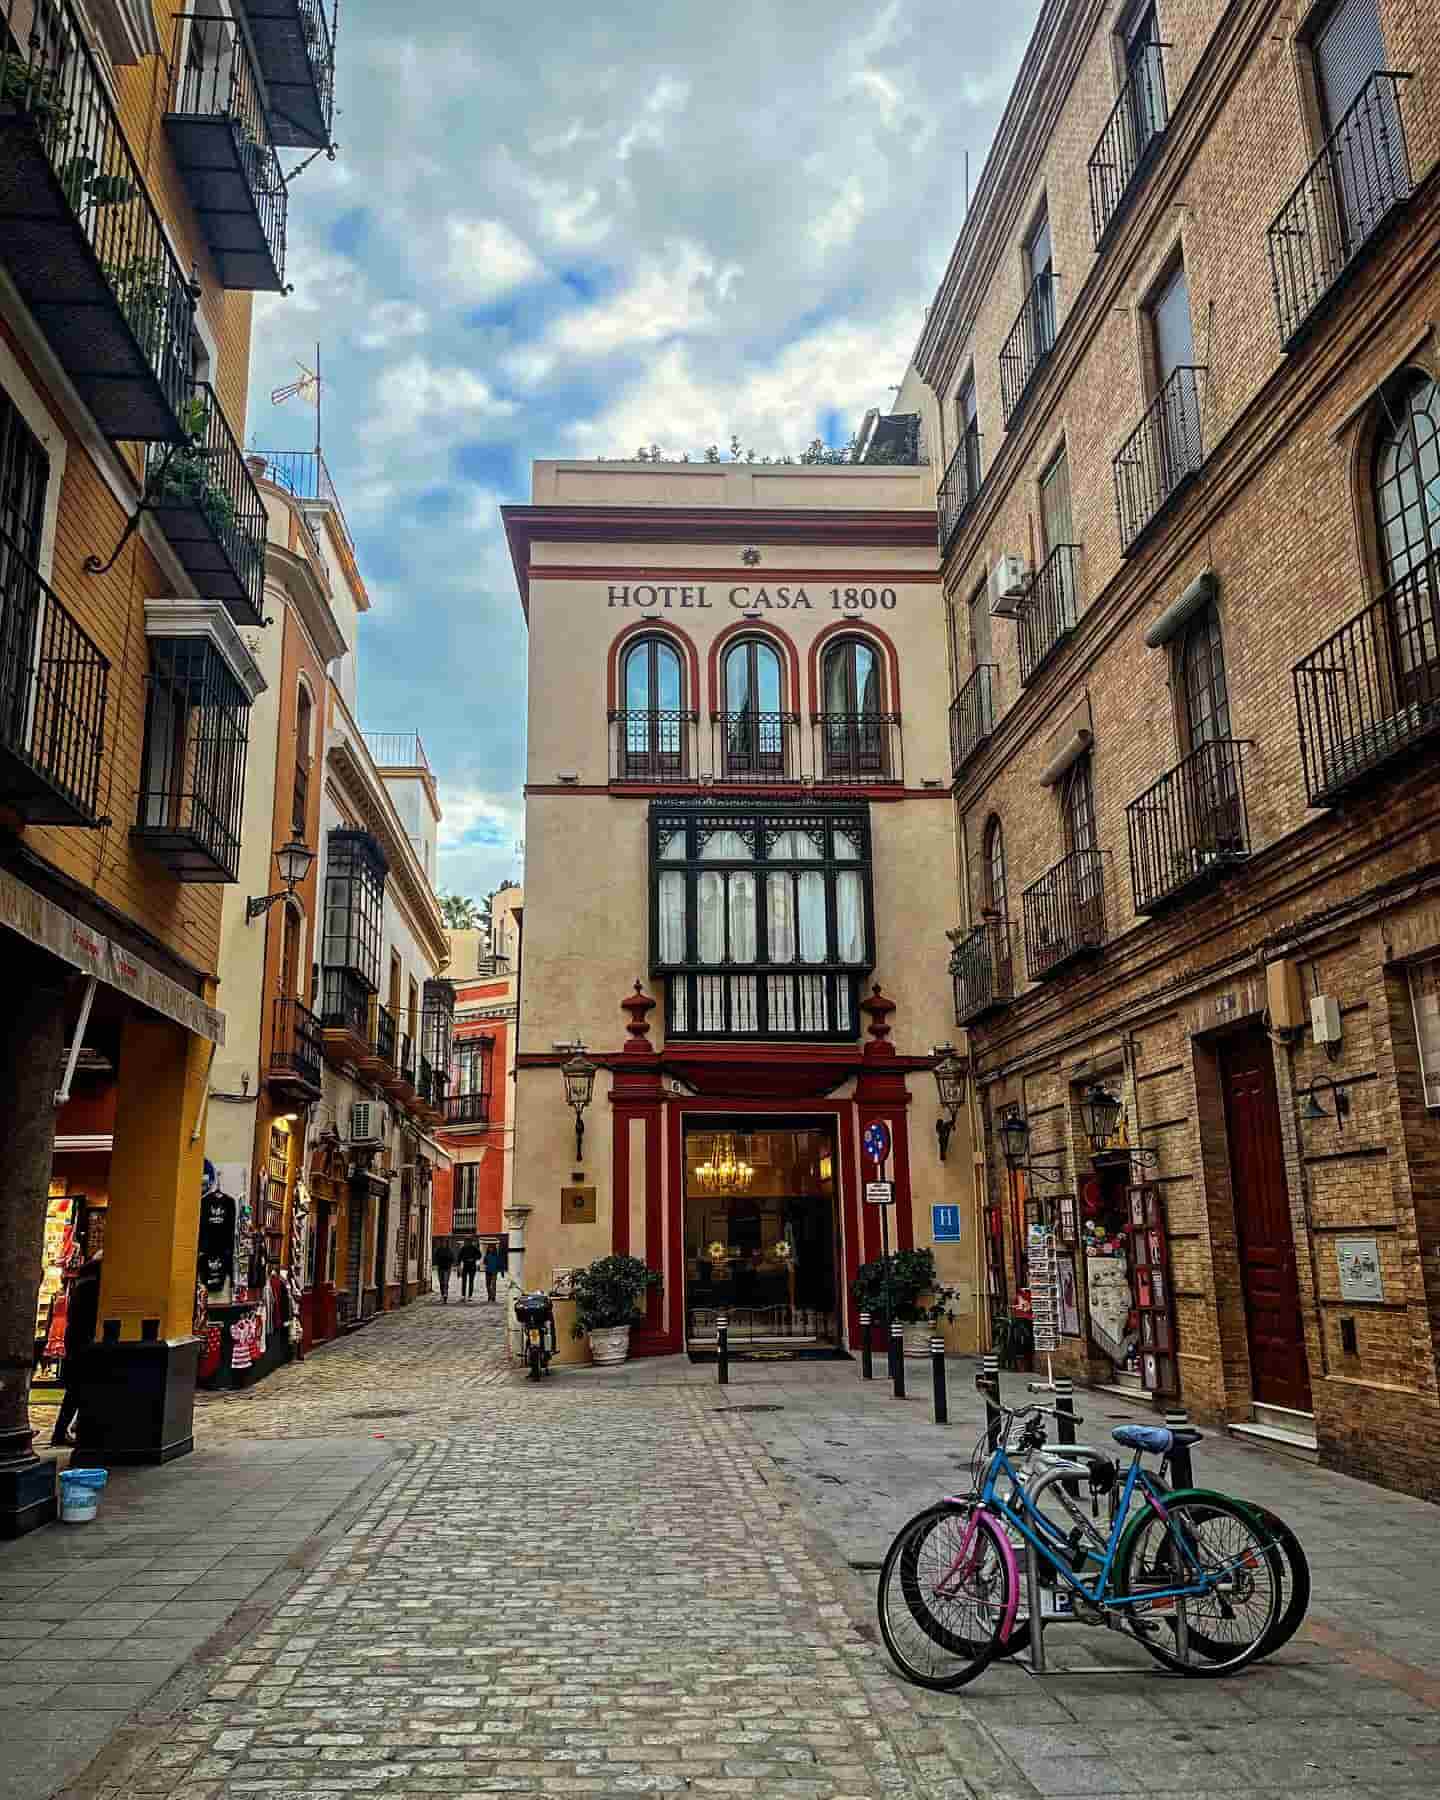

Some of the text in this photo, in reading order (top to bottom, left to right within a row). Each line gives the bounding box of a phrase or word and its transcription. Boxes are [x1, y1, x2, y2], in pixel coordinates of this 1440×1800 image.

[607, 585, 896, 610] HOTEL CASA 1800
